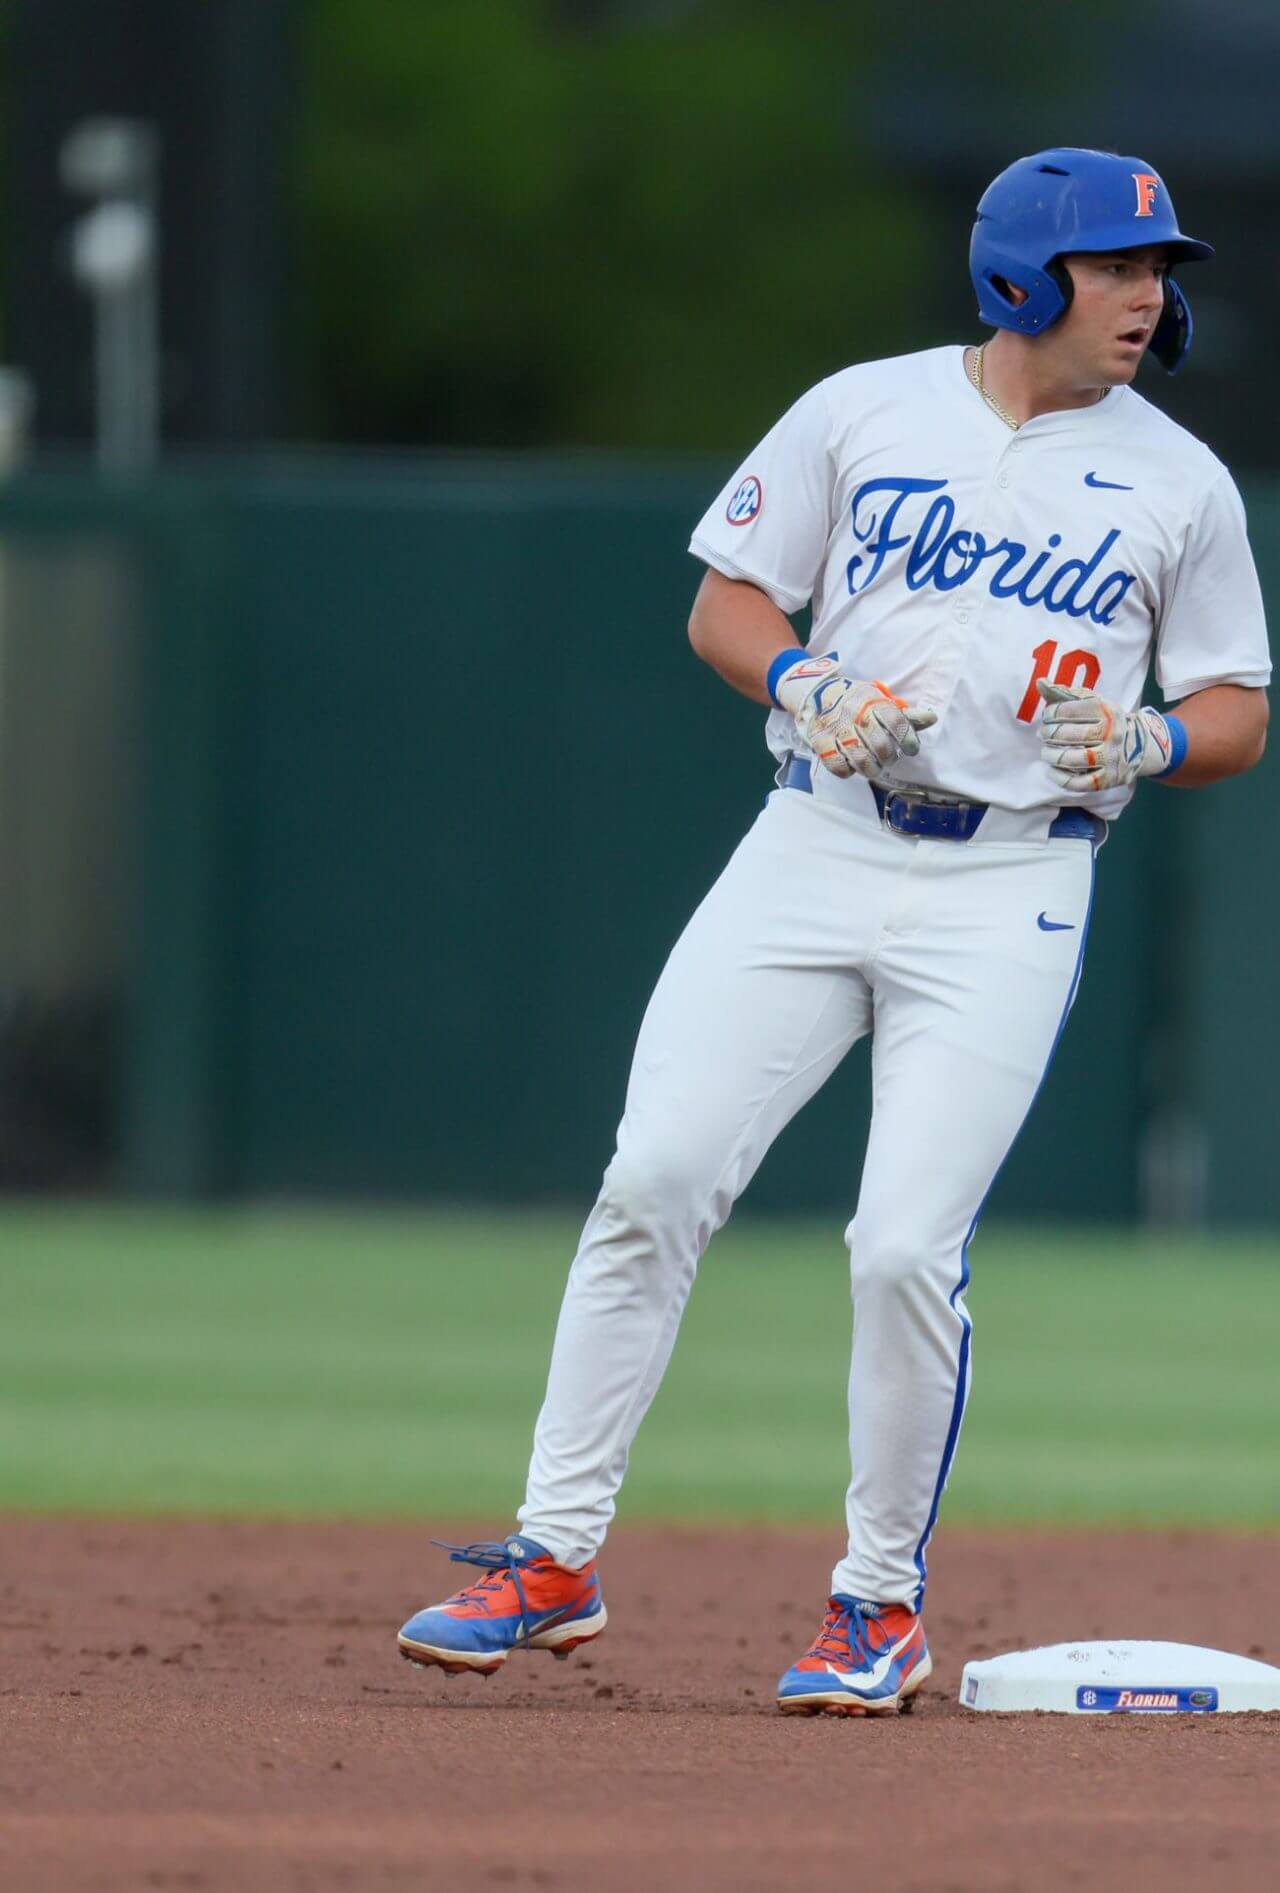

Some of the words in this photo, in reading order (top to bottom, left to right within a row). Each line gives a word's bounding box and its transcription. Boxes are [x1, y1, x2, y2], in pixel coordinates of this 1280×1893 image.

[1131, 173, 1159, 217] F
[846, 477, 1137, 626] Florida
[1116, 1691, 1178, 1708] FLORIDA
